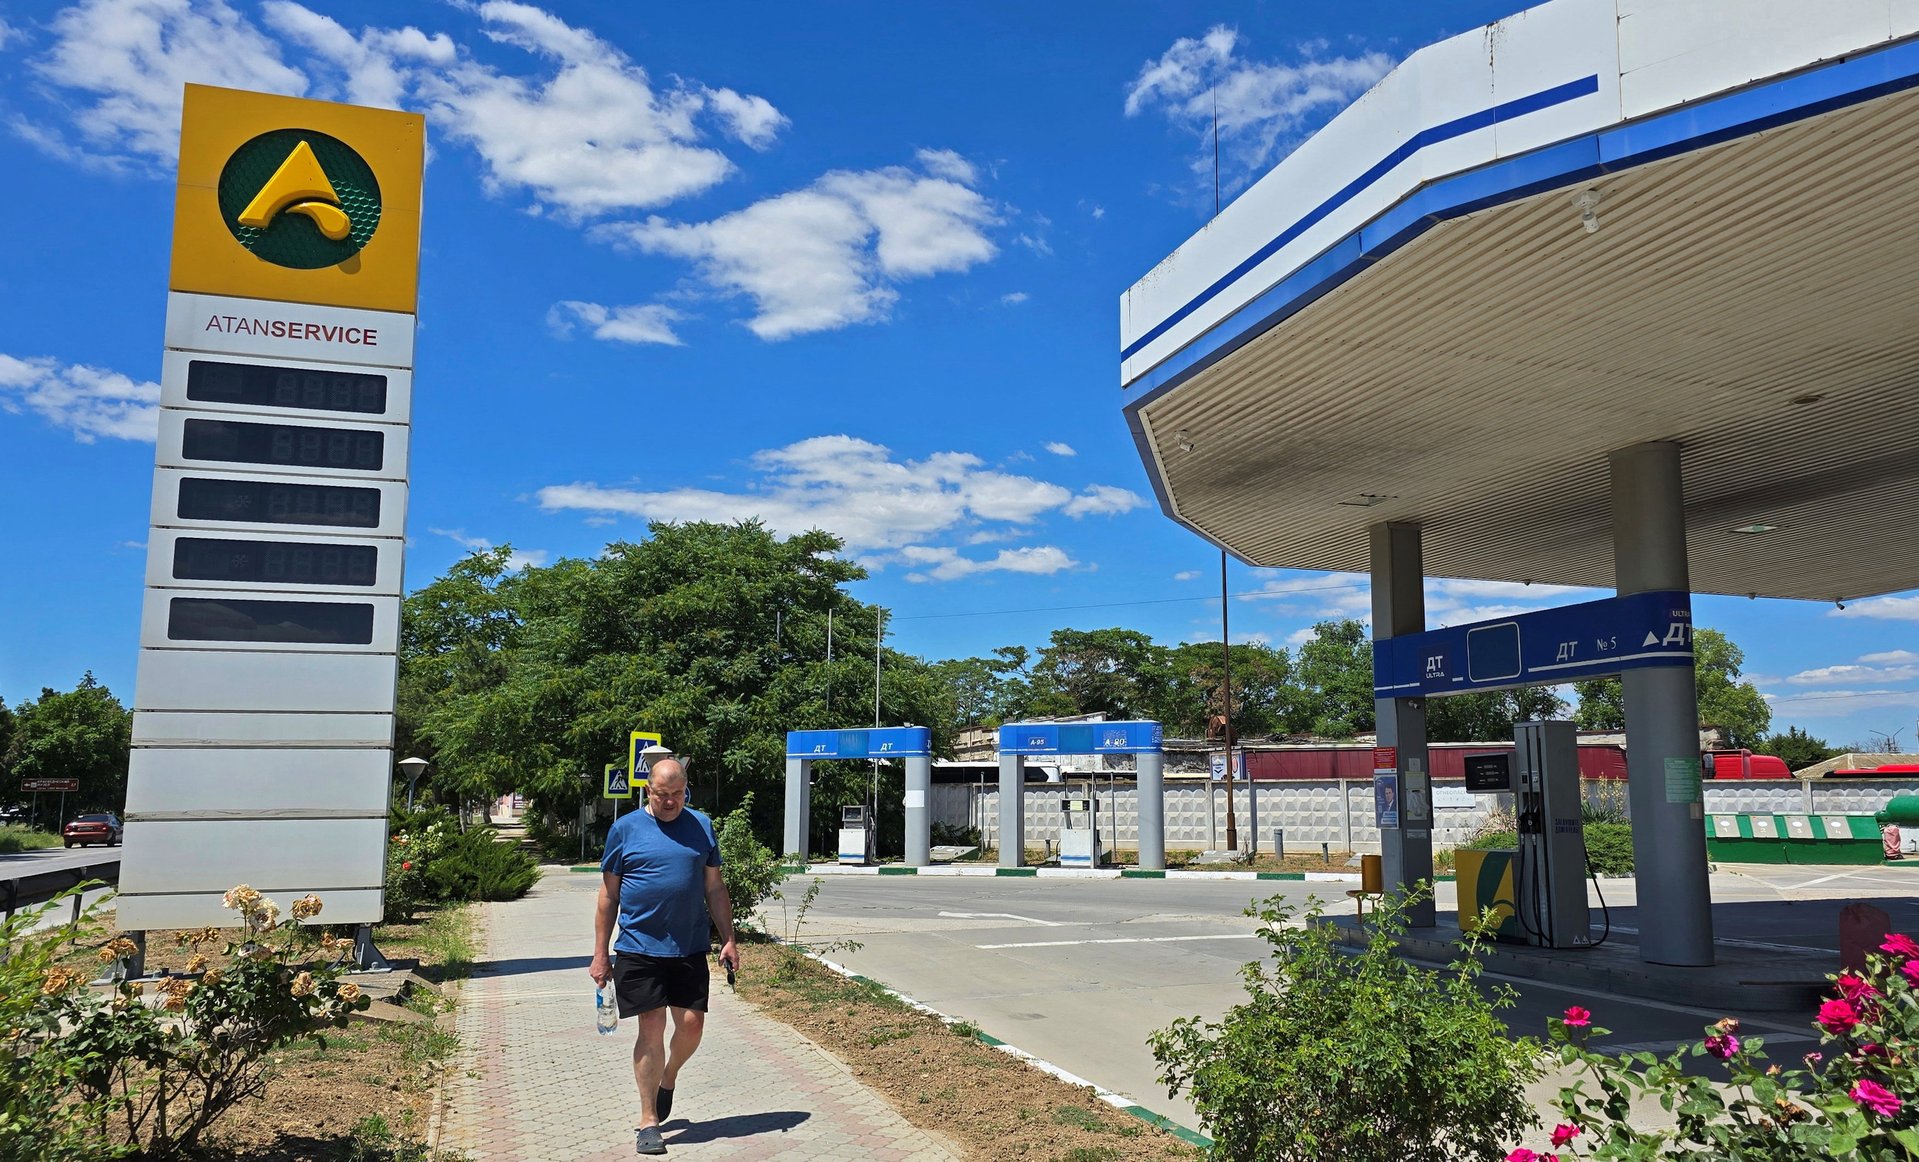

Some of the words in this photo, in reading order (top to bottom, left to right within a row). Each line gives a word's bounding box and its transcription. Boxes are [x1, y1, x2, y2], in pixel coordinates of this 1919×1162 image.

[205, 314, 378, 346] ATANSERVICE
[1662, 622, 1692, 646] ДТ
[1556, 641, 1578, 662] ДТ
[1610, 636, 1617, 650] 5
[1426, 655, 1443, 672] ДТ
[1425, 671, 1445, 679] ULTRA
[814, 744, 826, 753] ДТ
[880, 742, 893, 751] ДТ
